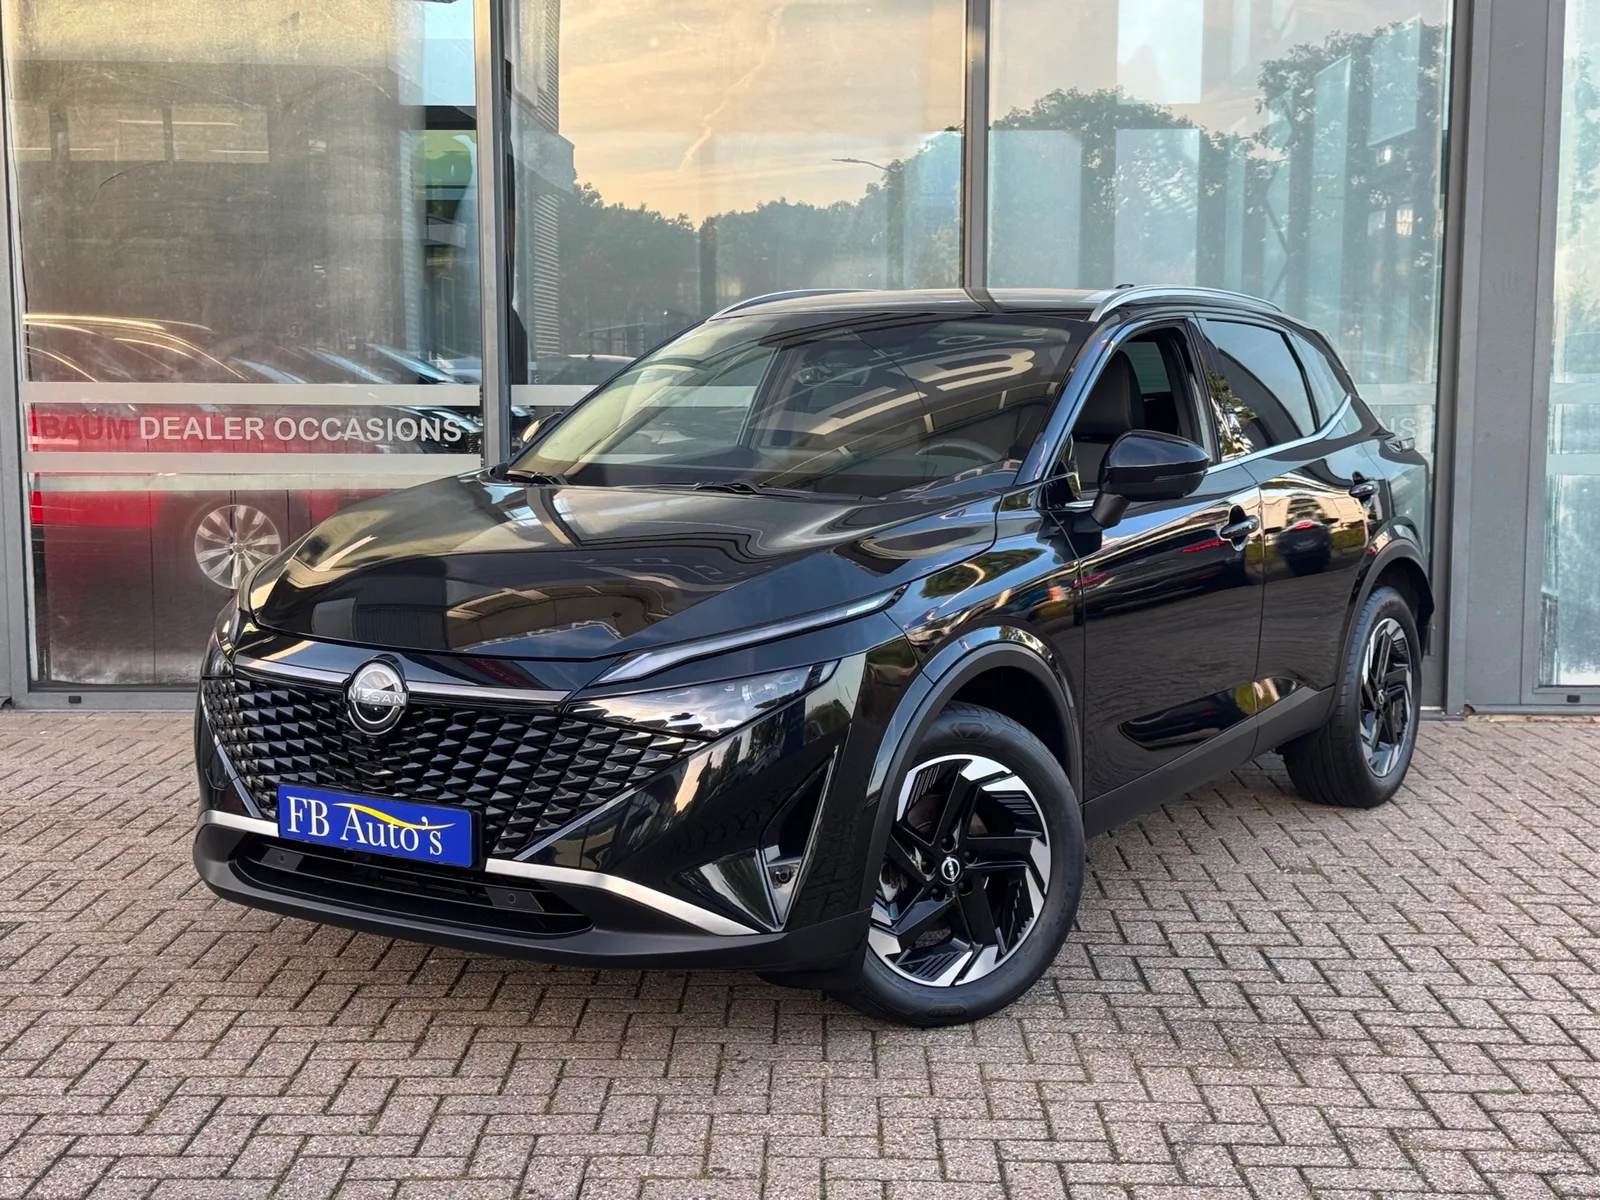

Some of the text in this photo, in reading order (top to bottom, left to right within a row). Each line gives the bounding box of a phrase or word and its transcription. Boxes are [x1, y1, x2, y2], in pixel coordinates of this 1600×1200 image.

[40, 415, 463, 442] BAUM DEALER OCCASIONS
[286, 796, 443, 855] FB Auto's
